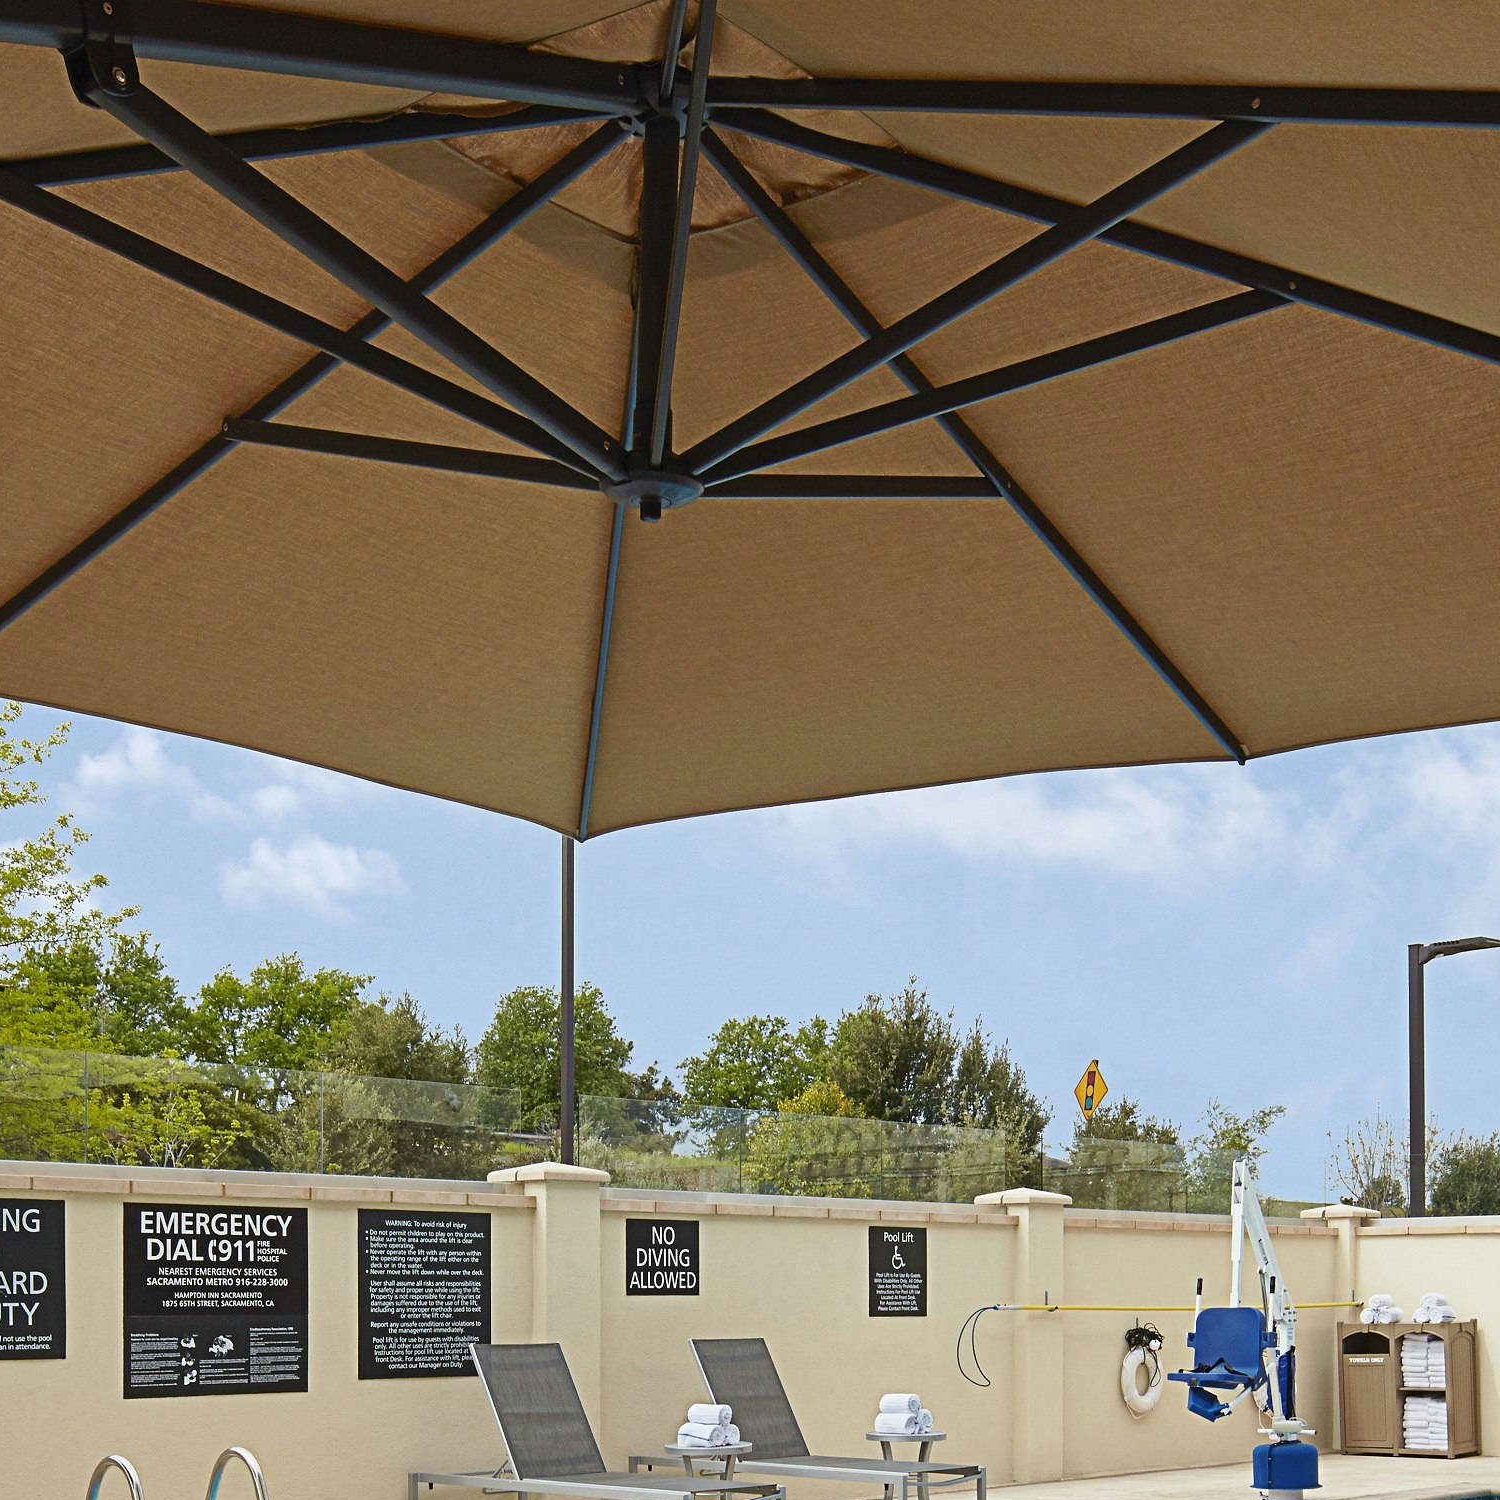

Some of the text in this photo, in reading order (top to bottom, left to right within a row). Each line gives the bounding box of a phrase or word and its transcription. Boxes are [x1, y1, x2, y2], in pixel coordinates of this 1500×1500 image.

[141, 1211, 292, 1237] EMERGENCY
[452, 1222, 467, 1230] injury
[389, 1230, 406, 1238] permit
[435, 1230, 446, 1238] play
[652, 1226, 675, 1245] NO
[884, 1231, 914, 1243] Pool Lift
[147, 1238, 254, 1262] DIAL 911
[636, 1248, 690, 1267] DIVING
[158, 1267, 277, 1276] NEAREST EMERGENCY SERVICES
[146, 1277, 288, 1286] SACRAMENTO METRO 916-228-3000
[445, 1280, 481, 1288] responsibilities
[629, 1270, 696, 1290] ALLOWED
[38, 1334, 52, 1343] pool
[418, 1362, 442, 1370] Manager
